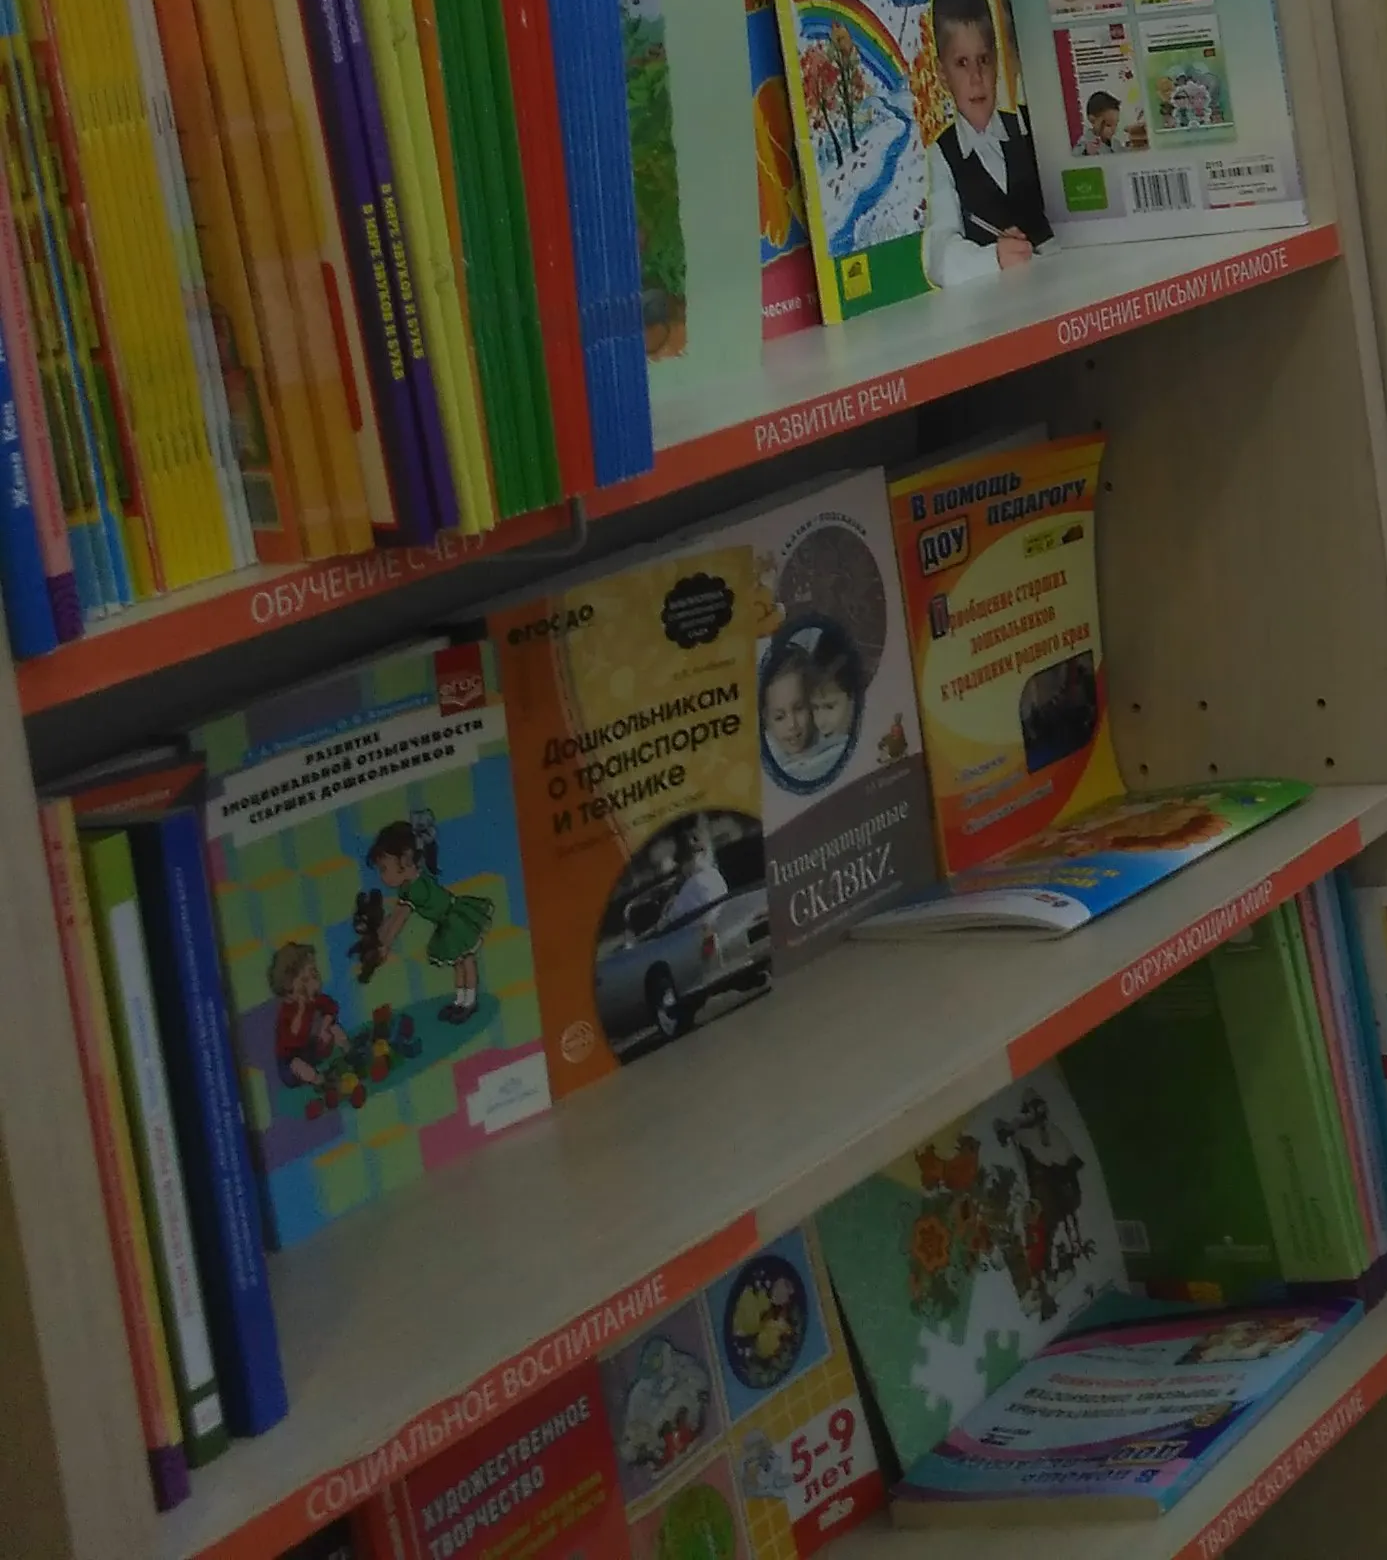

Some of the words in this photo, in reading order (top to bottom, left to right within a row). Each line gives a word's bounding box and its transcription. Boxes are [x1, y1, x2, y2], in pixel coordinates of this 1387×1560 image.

[1056, 297, 1142, 346] ОБУЧЕНИЕ
[1145, 274, 1209, 318] ПИСЬМУ
[1209, 267, 1223, 293] И
[1225, 246, 1290, 286] ГРАМОТЕ
[754, 391, 854, 453] РАЗВИТИЕ
[858, 377, 909, 419] РЕЧИ
[910, 493, 926, 523] В
[932, 470, 1022, 517] ПОМОЩЬ
[987, 477, 1087, 527] ПЕДАГОГУ
[922, 523, 966, 574] ДОУ
[250, 549, 402, 625] ОБУЧЕНИЕ
[507, 612, 560, 646] ФГОС
[566, 603, 594, 628] ДО
[929, 589, 1014, 641] Приобщение
[1016, 568, 1068, 605] старших
[969, 604, 1057, 658] дошкольников
[1061, 621, 1090, 651] края
[305, 731, 381, 766] РАЗВИТИЕ
[542, 682, 740, 770] Дошкольникам
[547, 777, 568, 800] о
[574, 713, 742, 791] транспорте
[222, 756, 353, 818] ЭМОЦИОНАЛЬНОЙ
[356, 718, 485, 766] ОТЗЫВЧИВОСТИ
[249, 790, 317, 825] СТАРШИХ
[320, 743, 456, 801] ДОШКОЛЬНИКОВ
[552, 810, 573, 836] и
[579, 763, 687, 826] технике
[788, 842, 897, 929] СКАЗКИ
[1119, 900, 1235, 998] ОКРУЖАЮЩИЙ
[1237, 879, 1274, 922] МИР
[305, 1378, 498, 1522] СОЦИАЛЬНОЕ
[500, 1273, 668, 1397] ВОСПИТАНИЕ
[420, 1394, 593, 1533] ХУДОЖЕСТВЕННОЕ
[789, 1407, 858, 1483] 5-9
[802, 1457, 856, 1505] лет
[1196, 1460, 1295, 1560] ТВОРЧЕСКОЕ
[1294, 1388, 1368, 1470] РАЗВИТИЕ
[428, 1467, 546, 1560] ТВОРЧЕСТВО
